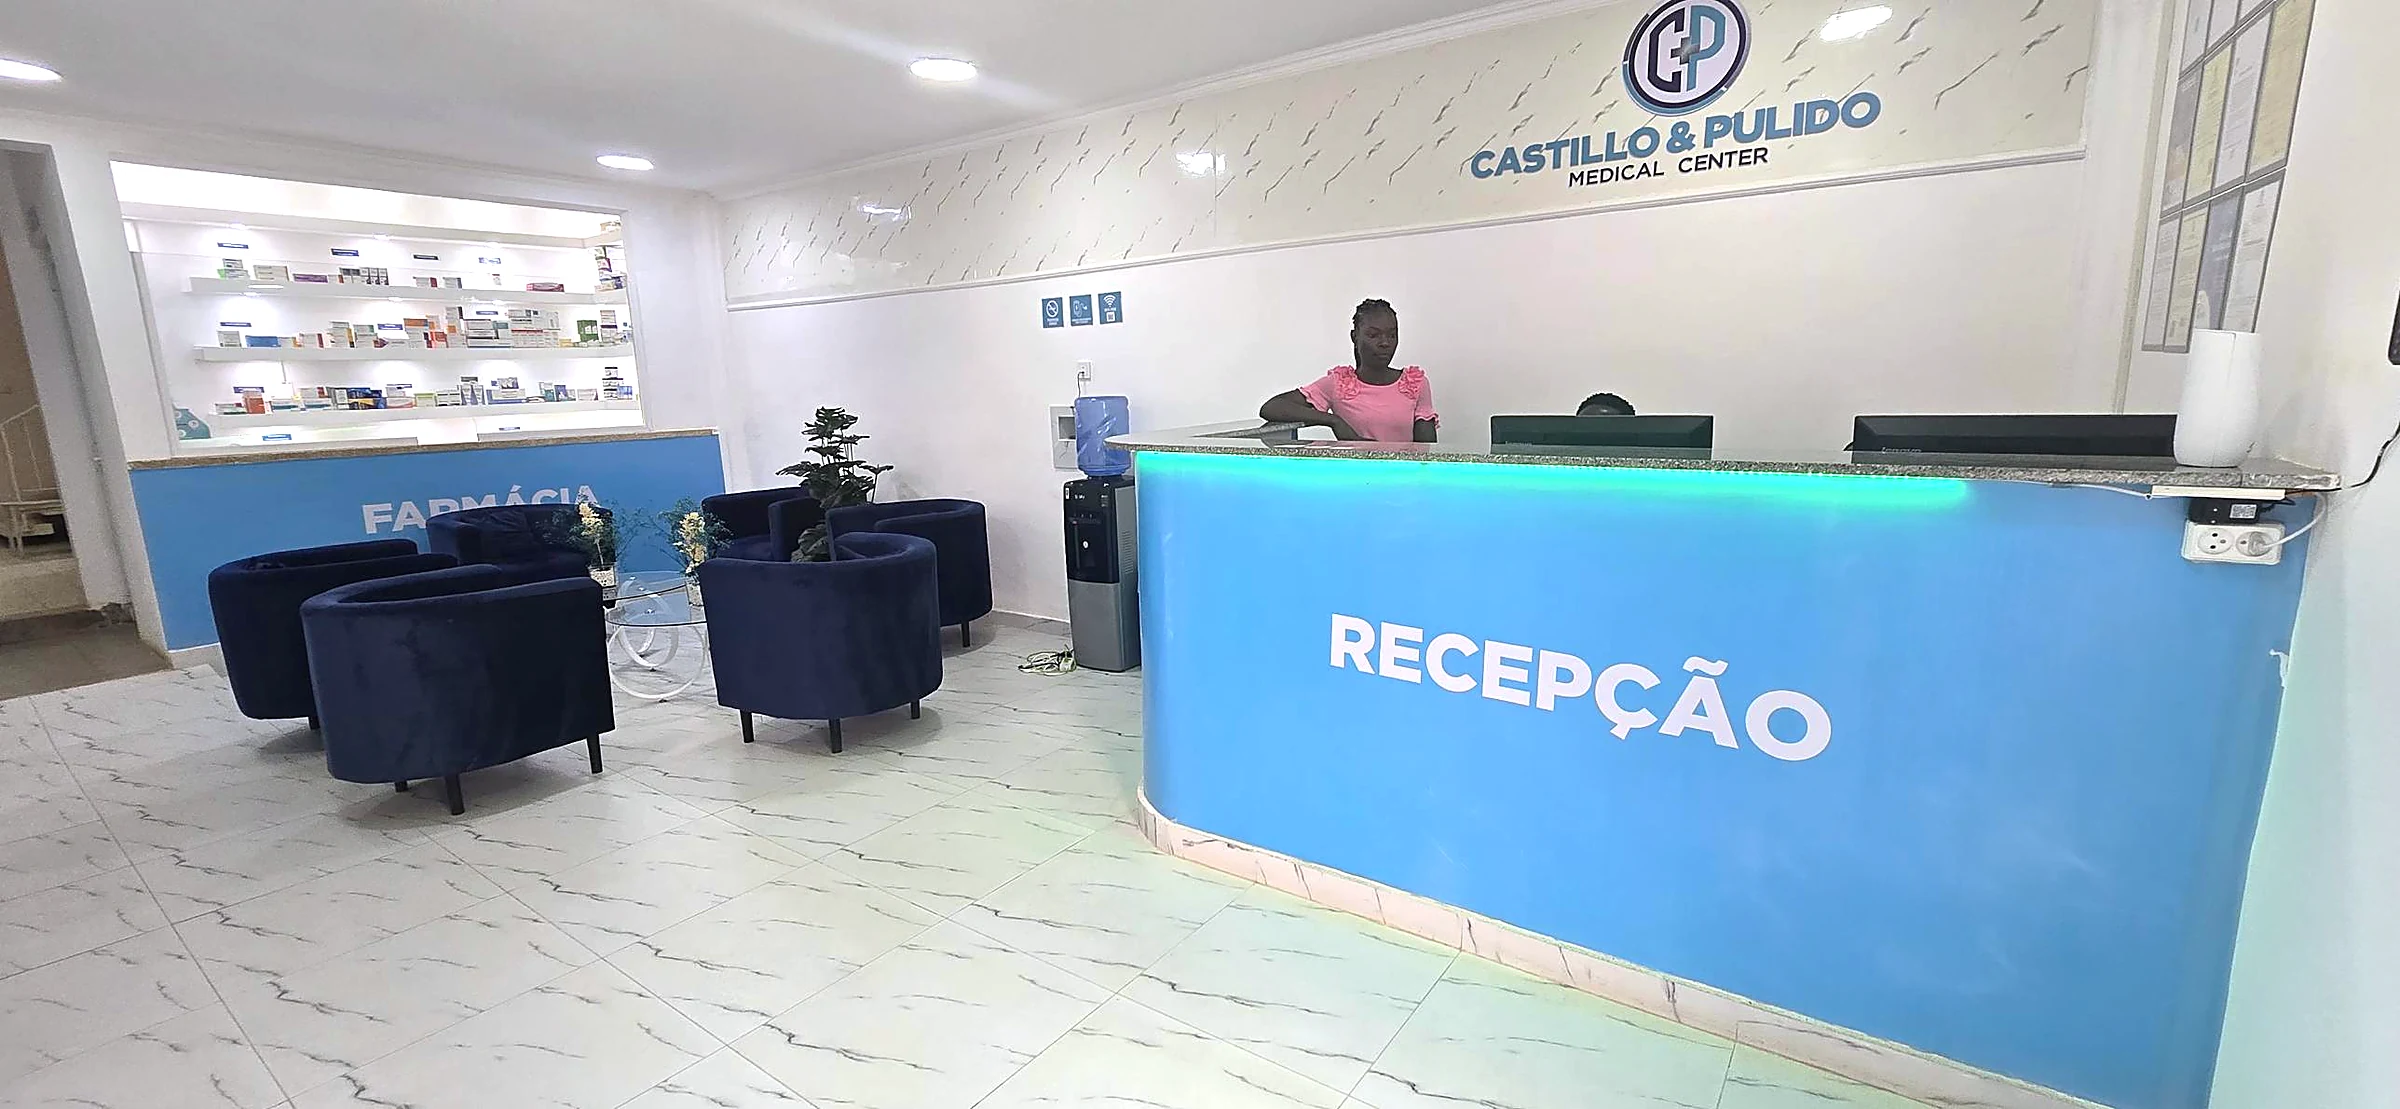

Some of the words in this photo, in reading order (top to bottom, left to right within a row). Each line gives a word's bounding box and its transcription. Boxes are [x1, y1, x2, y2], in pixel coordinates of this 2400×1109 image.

[1470, 126, 1661, 179] CASTILLO
[1666, 121, 1696, 154] &
[1704, 91, 1882, 149] PULIDO
[1568, 160, 1665, 188] MEDICAL
[1678, 147, 1769, 174] CENTER
[1329, 612, 1833, 762] RECEPÇÃO
